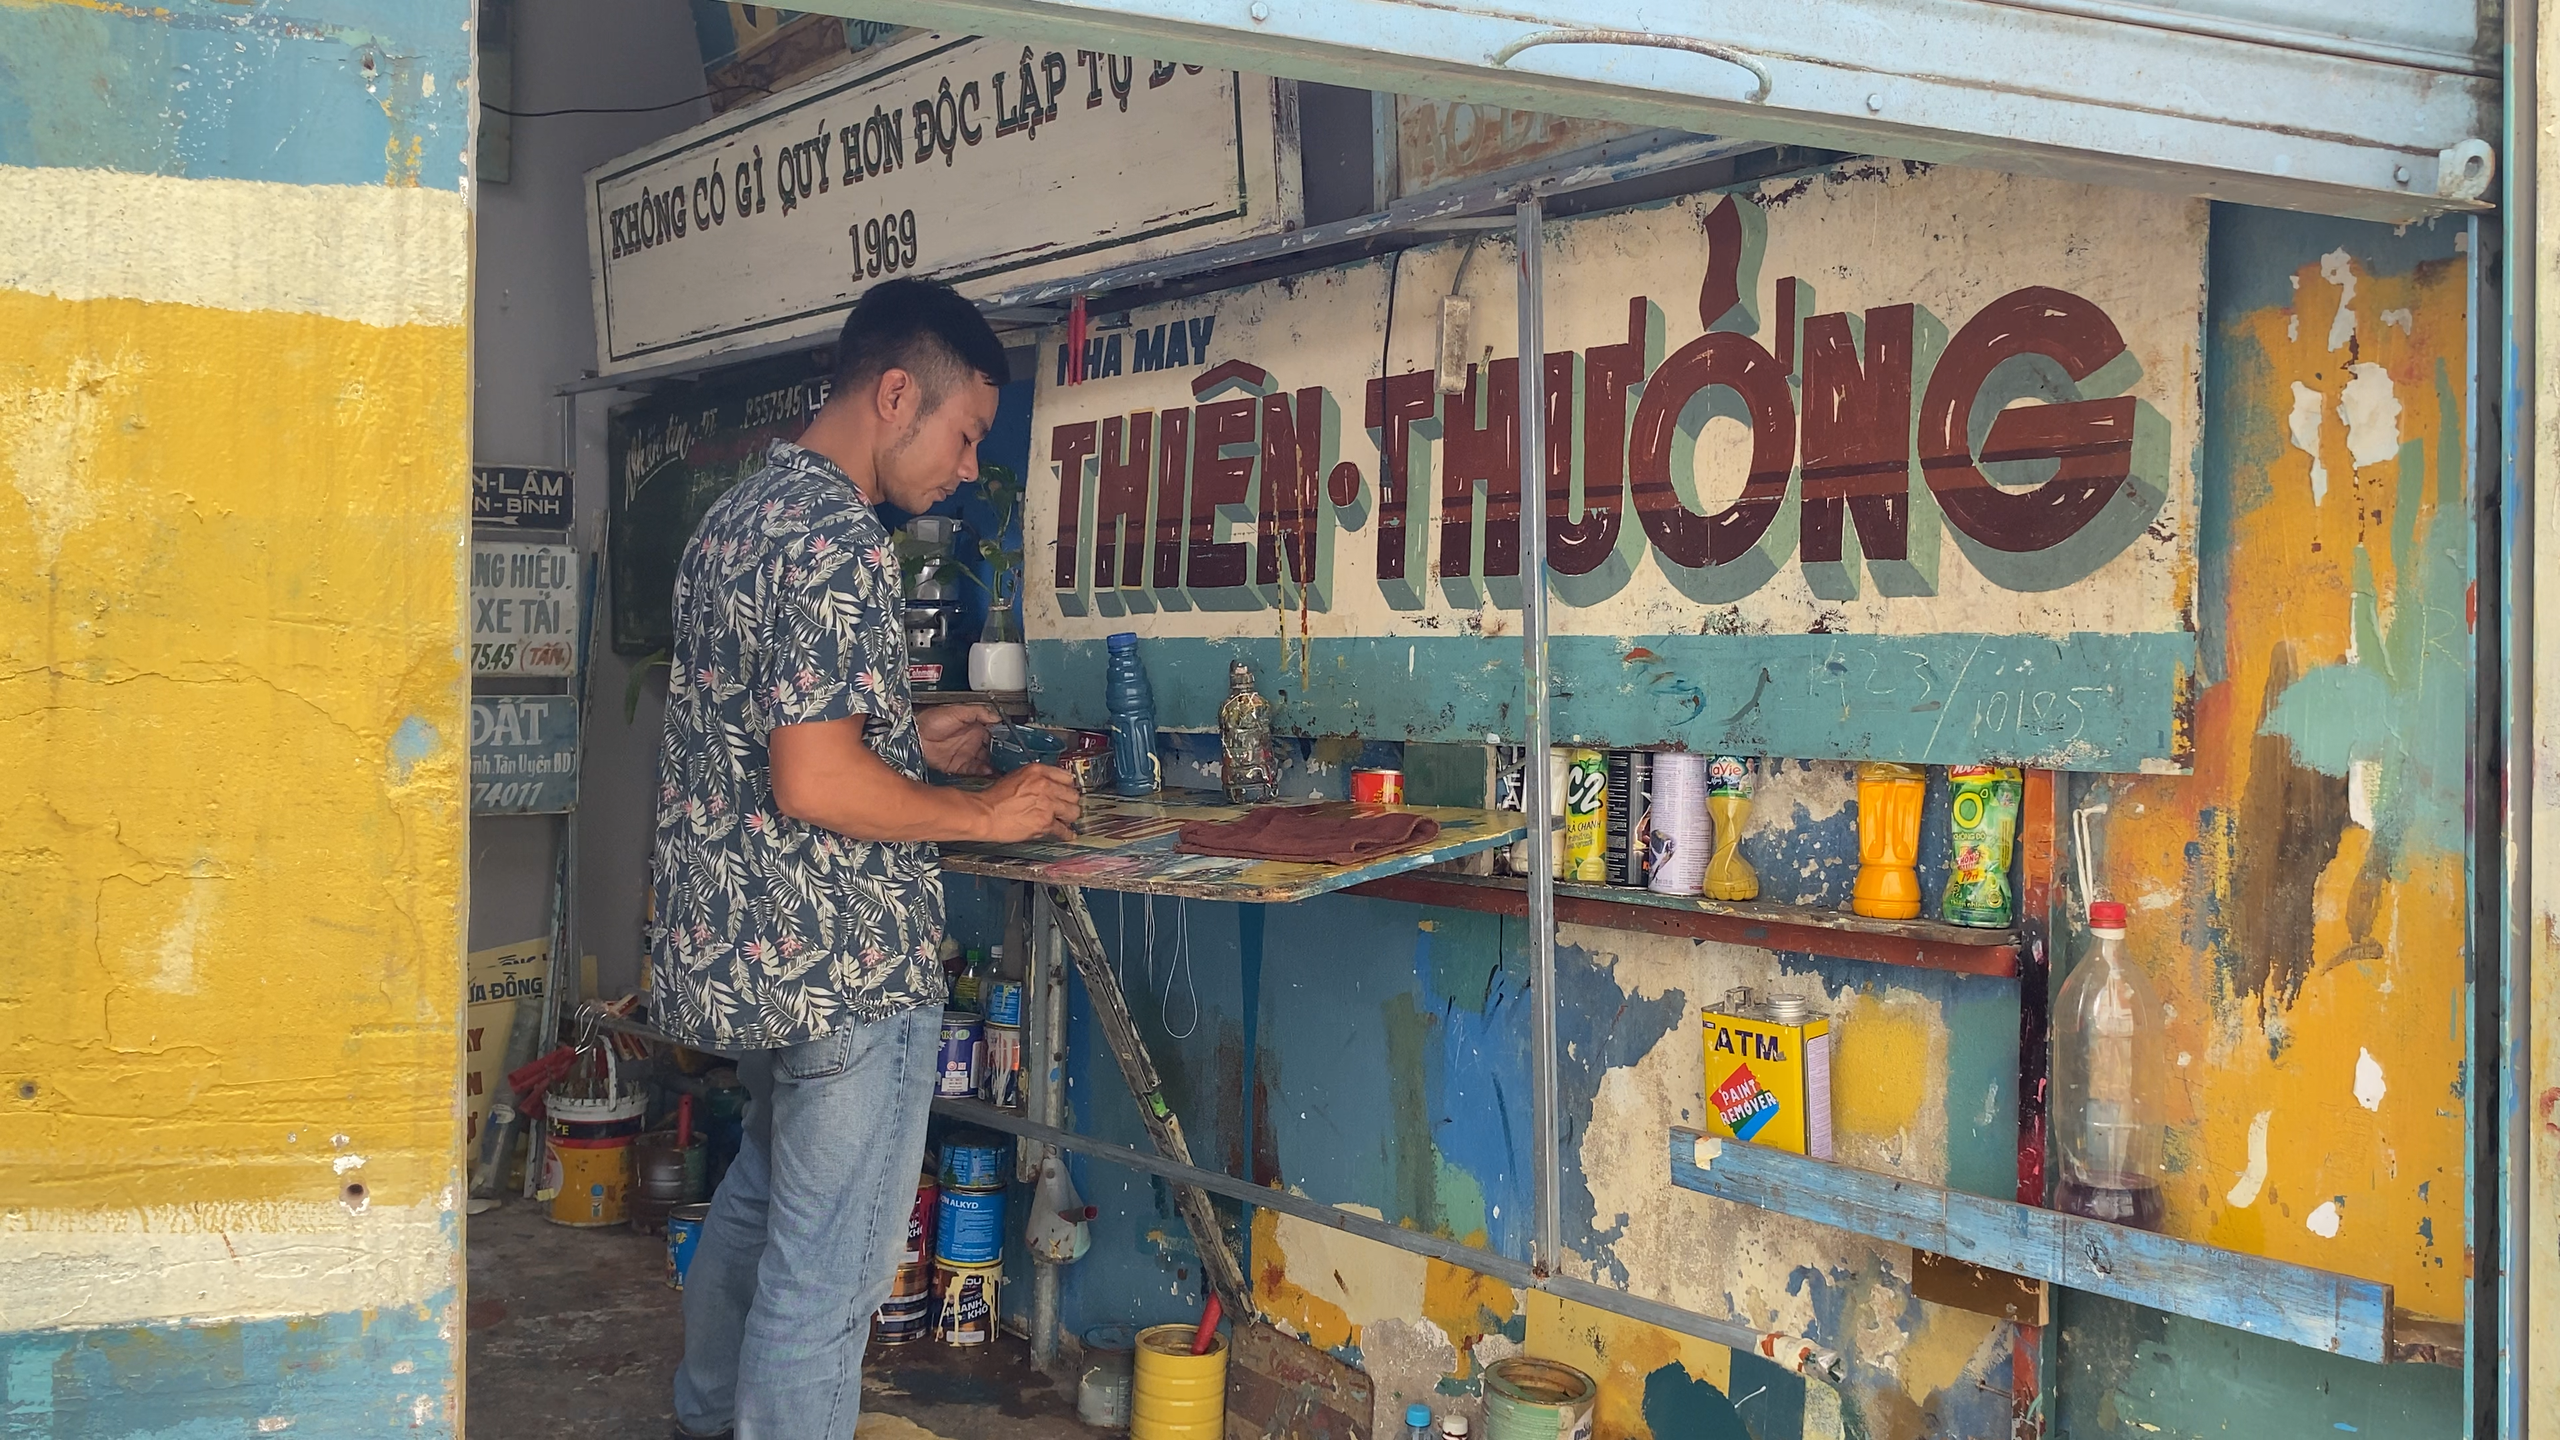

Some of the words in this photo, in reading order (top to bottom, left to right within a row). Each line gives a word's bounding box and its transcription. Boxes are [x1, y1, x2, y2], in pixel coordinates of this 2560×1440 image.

[609, 186, 687, 260] KHÔNG
[693, 157, 726, 231] CÓ
[735, 144, 766, 218] GÌ
[777, 119, 831, 218] QUÝ
[840, 104, 903, 186] HƠN
[912, 76, 983, 168] ĐỘC
[991, 45, 1067, 141] LẬP
[849, 209, 918, 282] 1969
[1132, 315, 1216, 374] MAY
[471, 552, 505, 588] NG
[475, 598, 512, 634] XE
[471, 781, 544, 808] 74011
[1568, 765, 1604, 813] C2
[1714, 1026, 1780, 1062] ATM
[1719, 1091, 1779, 1126] REMOVER
[1720, 1078, 1758, 1106] PAINT
[950, 1199, 979, 1210] ALKYD
[945, 1298, 983, 1318] NANH
